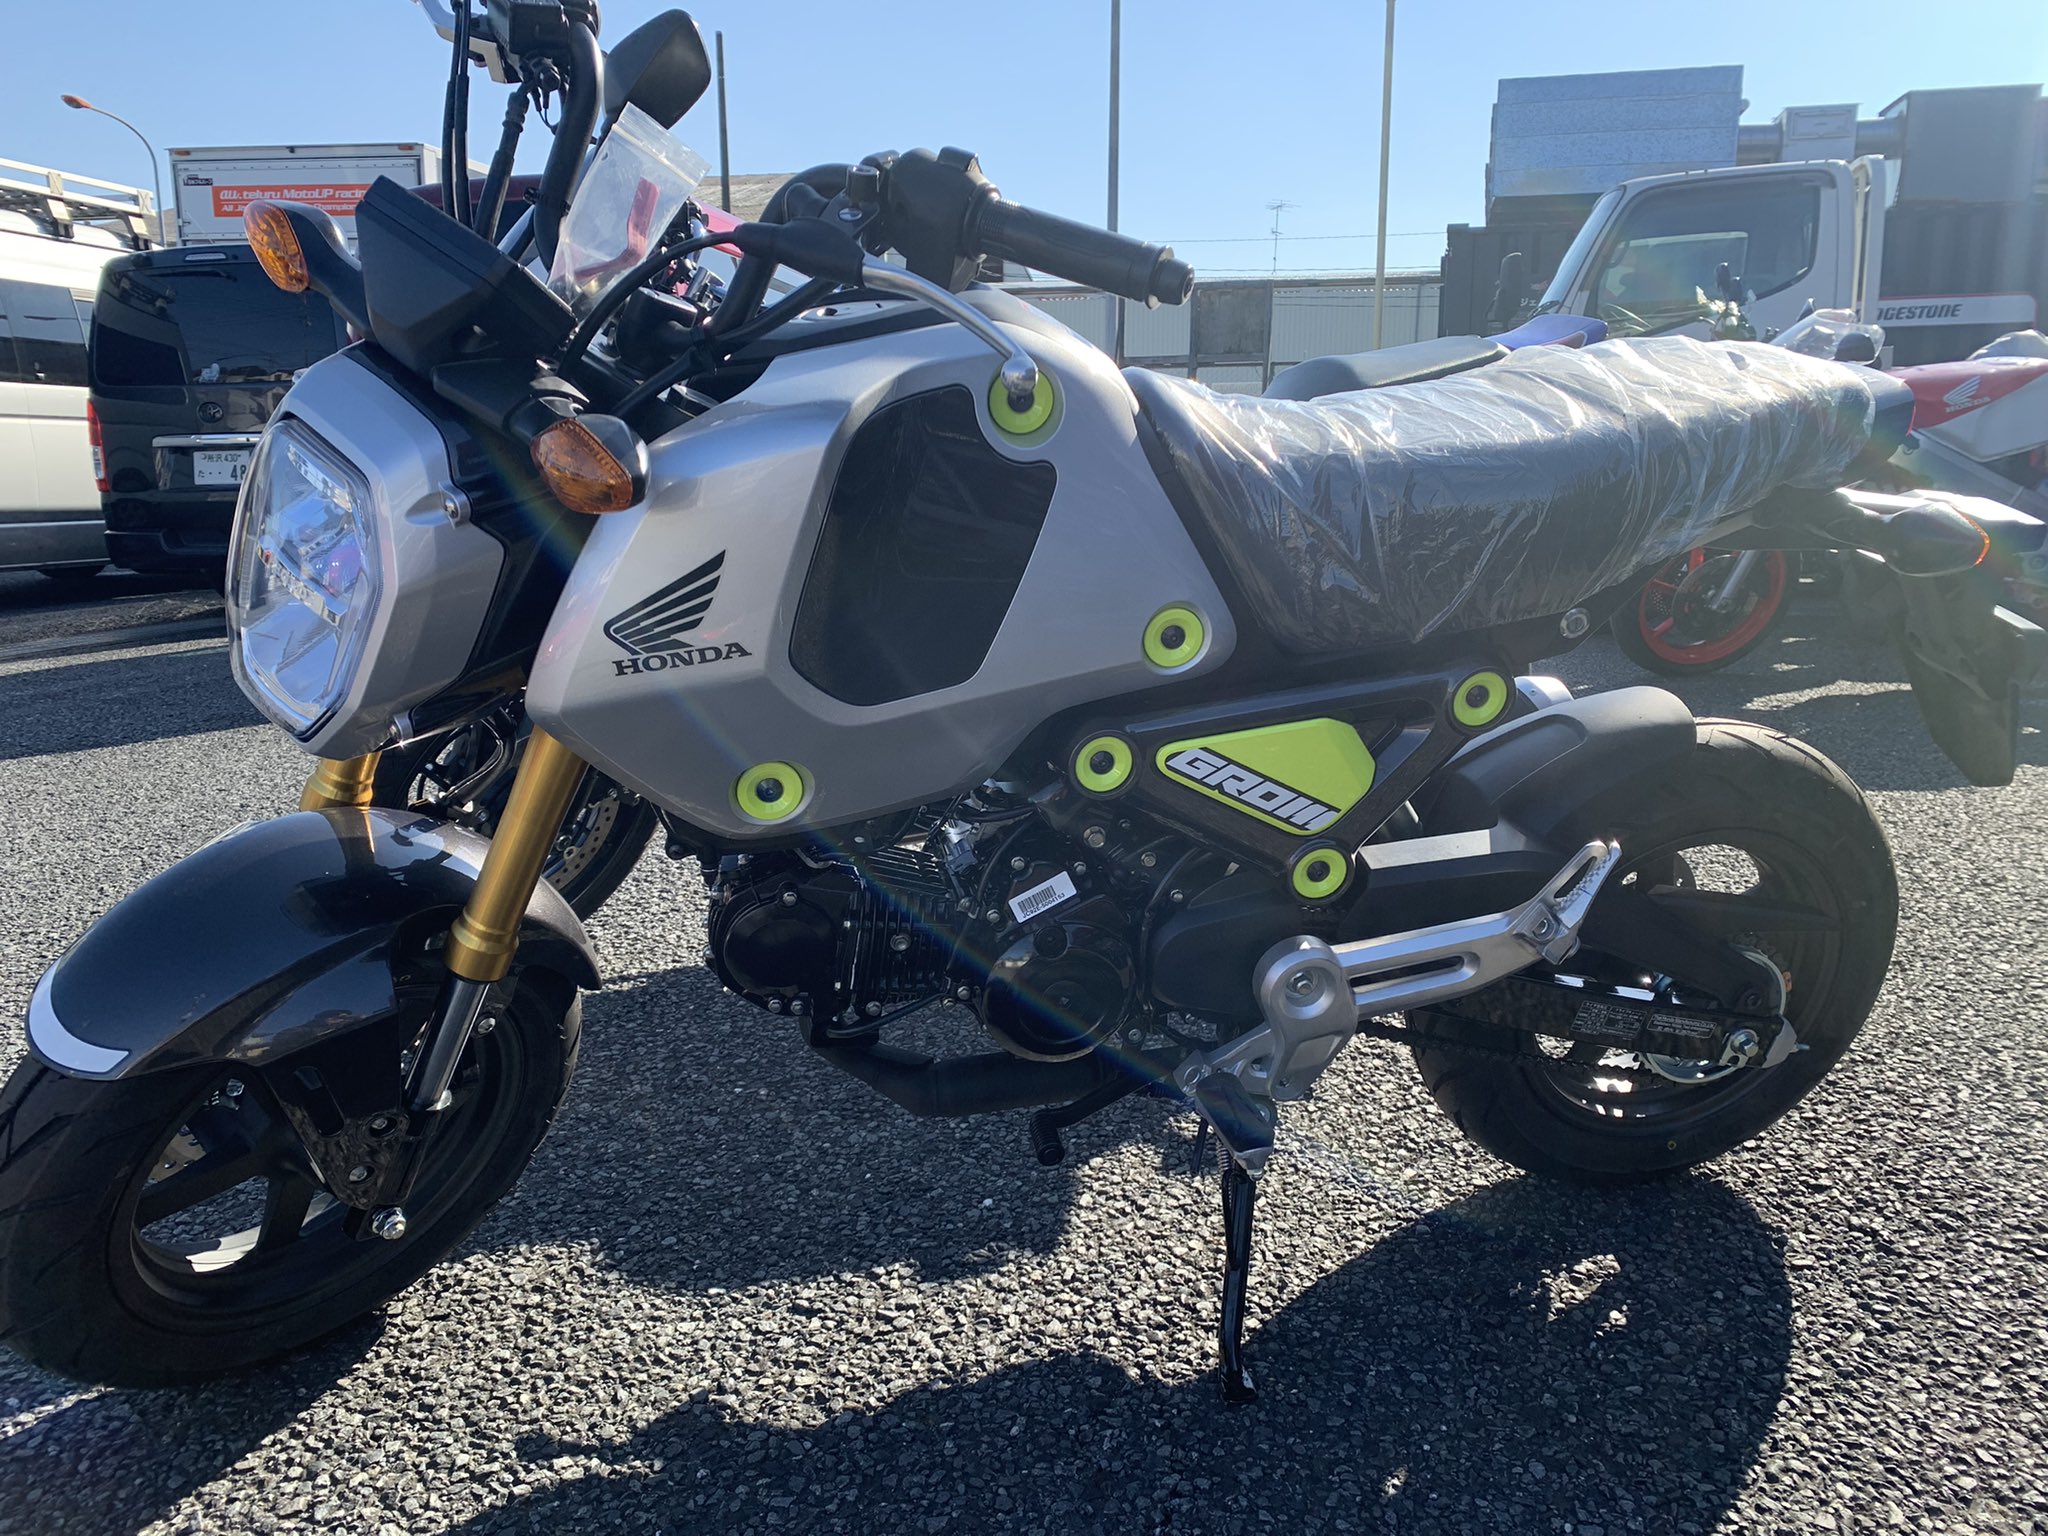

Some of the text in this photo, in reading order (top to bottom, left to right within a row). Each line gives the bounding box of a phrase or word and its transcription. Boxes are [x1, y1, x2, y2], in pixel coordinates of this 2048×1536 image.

[335, 188, 367, 198] racin
[612, 642, 752, 676] HONDA
[1166, 748, 1340, 831] GROM
